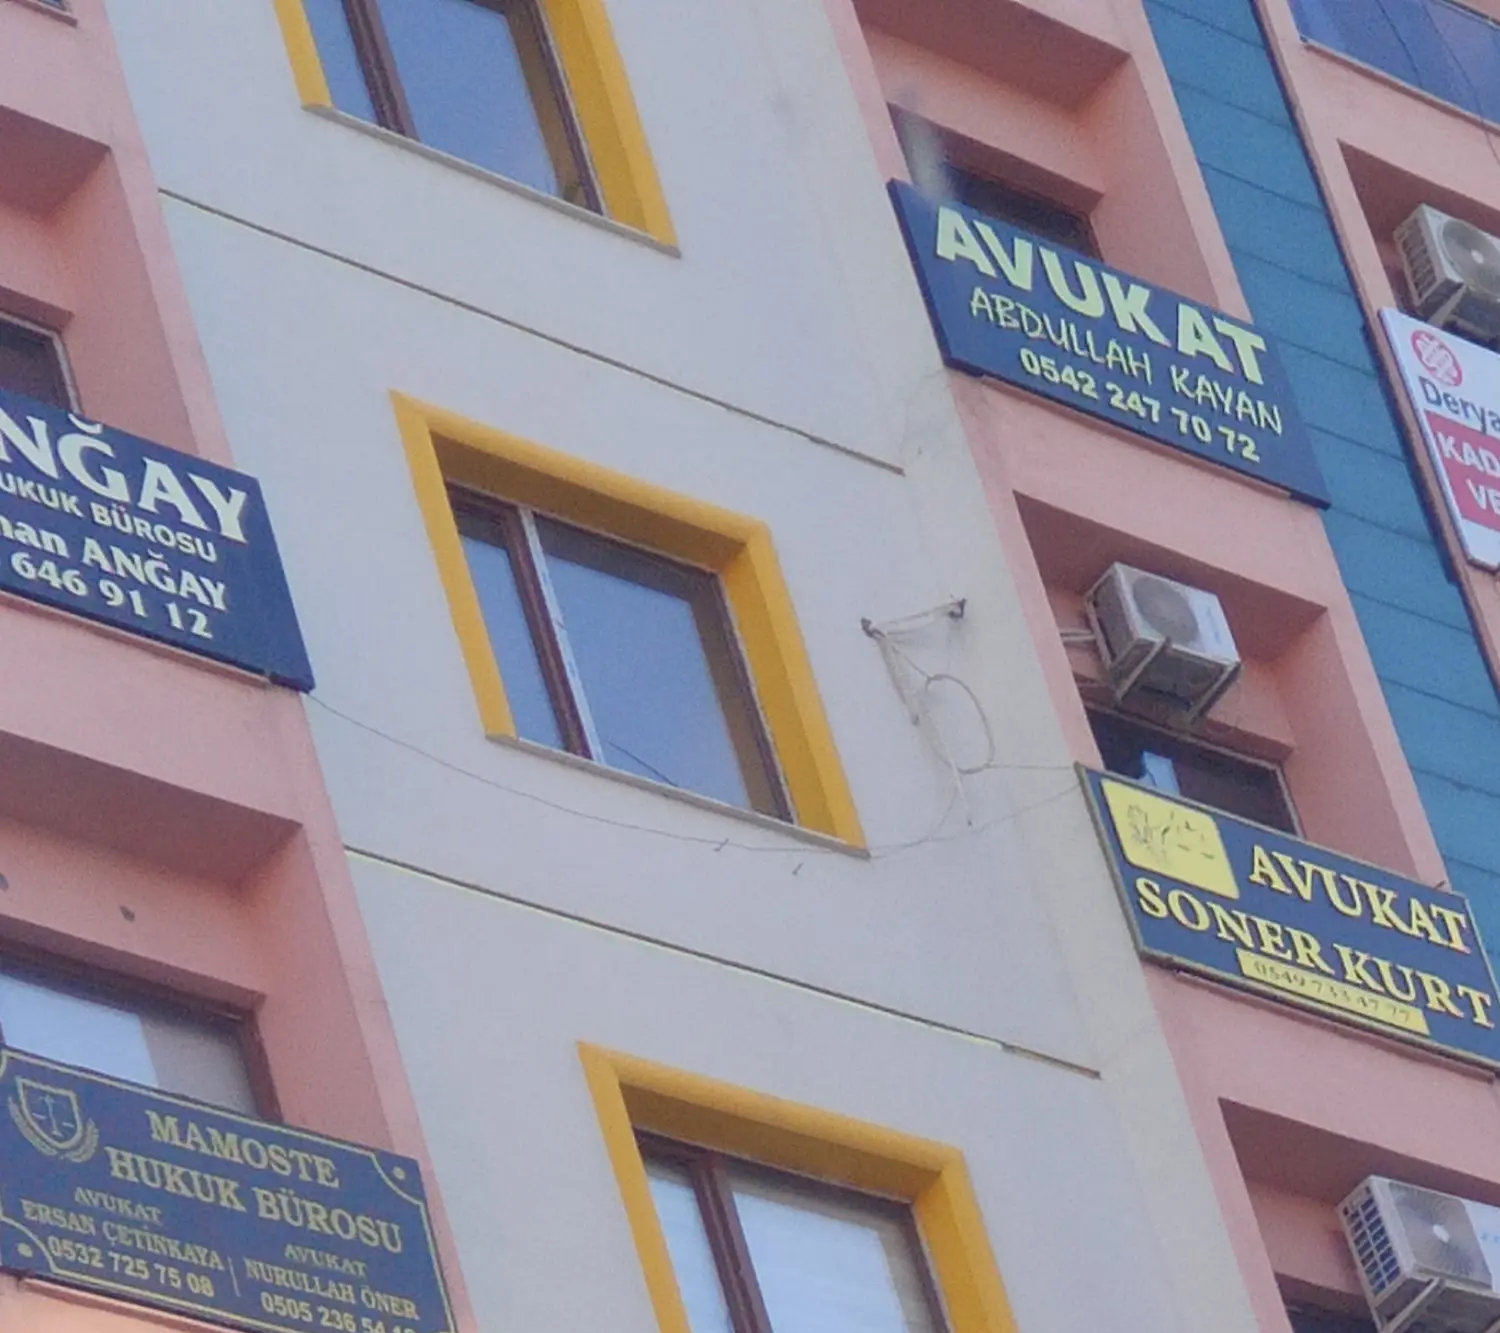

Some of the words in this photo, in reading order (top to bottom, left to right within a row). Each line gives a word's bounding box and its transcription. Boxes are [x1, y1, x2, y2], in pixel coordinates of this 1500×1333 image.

[936, 205, 1266, 384] AVUKAT
[971, 287, 1152, 385] ABDULLAH
[1171, 364, 1283, 436] KAYAN
[1020, 347, 1098, 399] 0542
[1107, 382, 1160, 422] 247
[1172, 408, 1211, 442] 70
[1219, 426, 1260, 462] 72
[90, 502, 217, 563] BÜROSU
[11, 552, 88, 596] 646
[99, 581, 148, 617] 91
[165, 602, 213, 638] 12
[82, 537, 227, 611] ANĞAY
[1249, 844, 1472, 954] AVUKAT
[1136, 878, 1336, 976] SONER
[1334, 943, 1495, 1028] KURT
[145, 1109, 340, 1188] MAMOSTE
[21, 1199, 96, 1237] ERSAN
[102, 1214, 225, 1272] ÇETİNKAYA
[75, 1187, 161, 1227] AVUKAT
[105, 1145, 246, 1213] HUKUK
[252, 1186, 402, 1253] BÜROSU
[49, 1237, 103, 1268] 0532
[112, 1253, 149, 1279] 725
[155, 1263, 182, 1287] 75
[244, 1258, 355, 1306] NURULLAH
[361, 1285, 419, 1321] ÖNER
[284, 1244, 366, 1278] AVUKAT
[261, 1292, 312, 1322] 0505
[318, 1304, 355, 1333] 236
